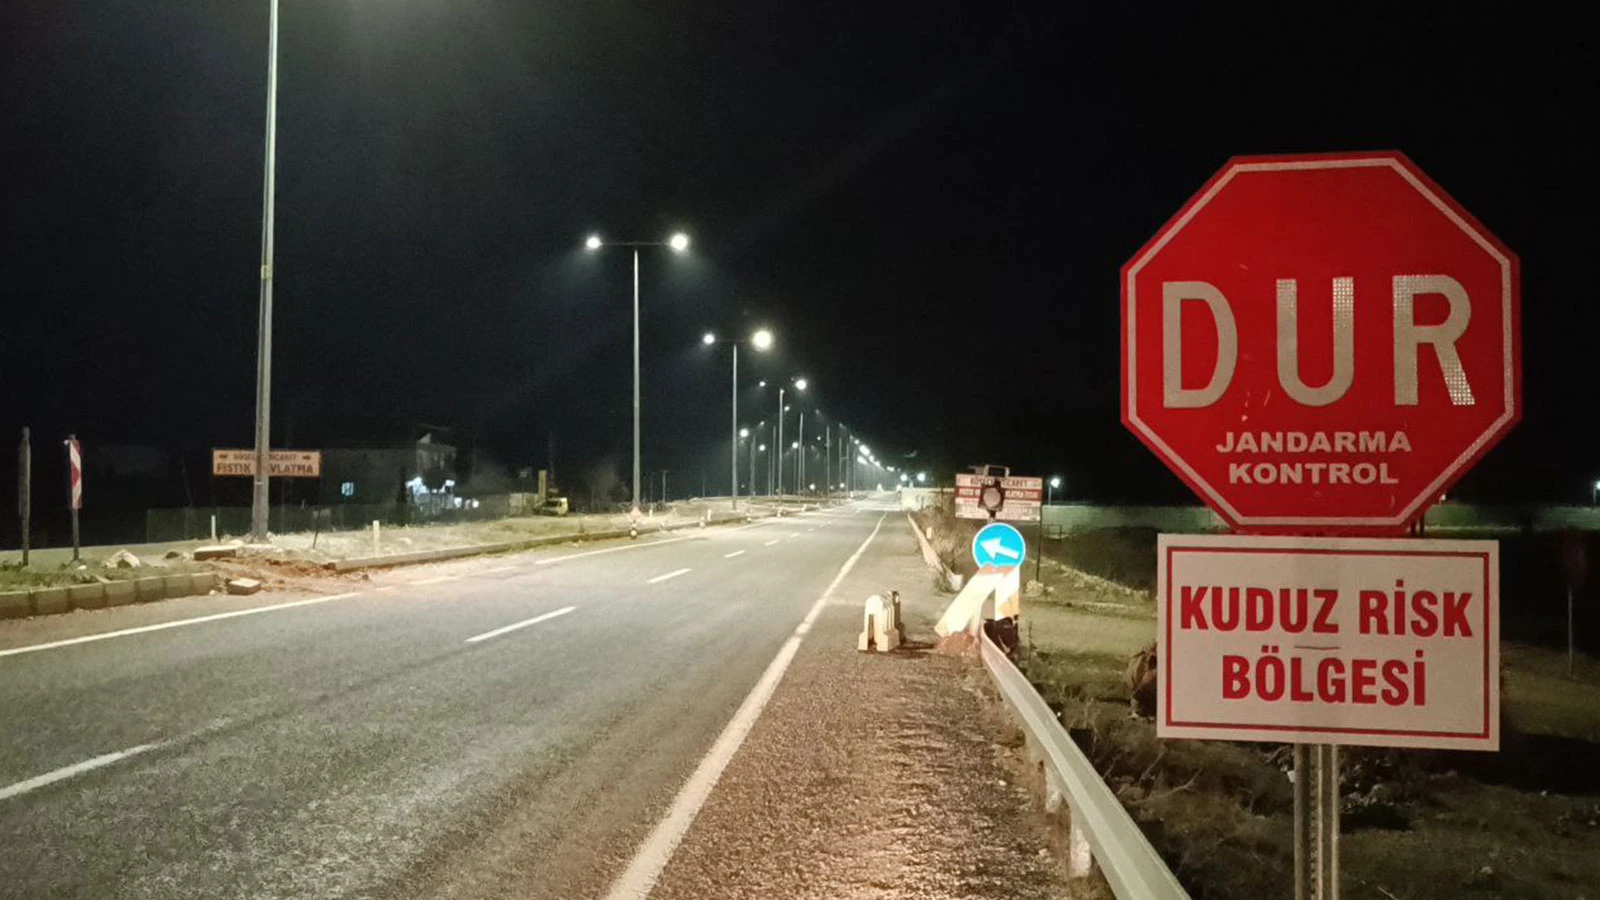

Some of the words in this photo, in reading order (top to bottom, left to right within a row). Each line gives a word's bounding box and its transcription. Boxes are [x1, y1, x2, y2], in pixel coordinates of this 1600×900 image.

[1162, 274, 1475, 409] DUR
[1216, 431, 1412, 454] JANDARMA
[1229, 462, 1399, 485] KONTROL
[1180, 585, 1339, 634] KUDUZ
[1359, 578, 1474, 638] RİSK
[1221, 644, 1427, 707] BÖLGESİ
